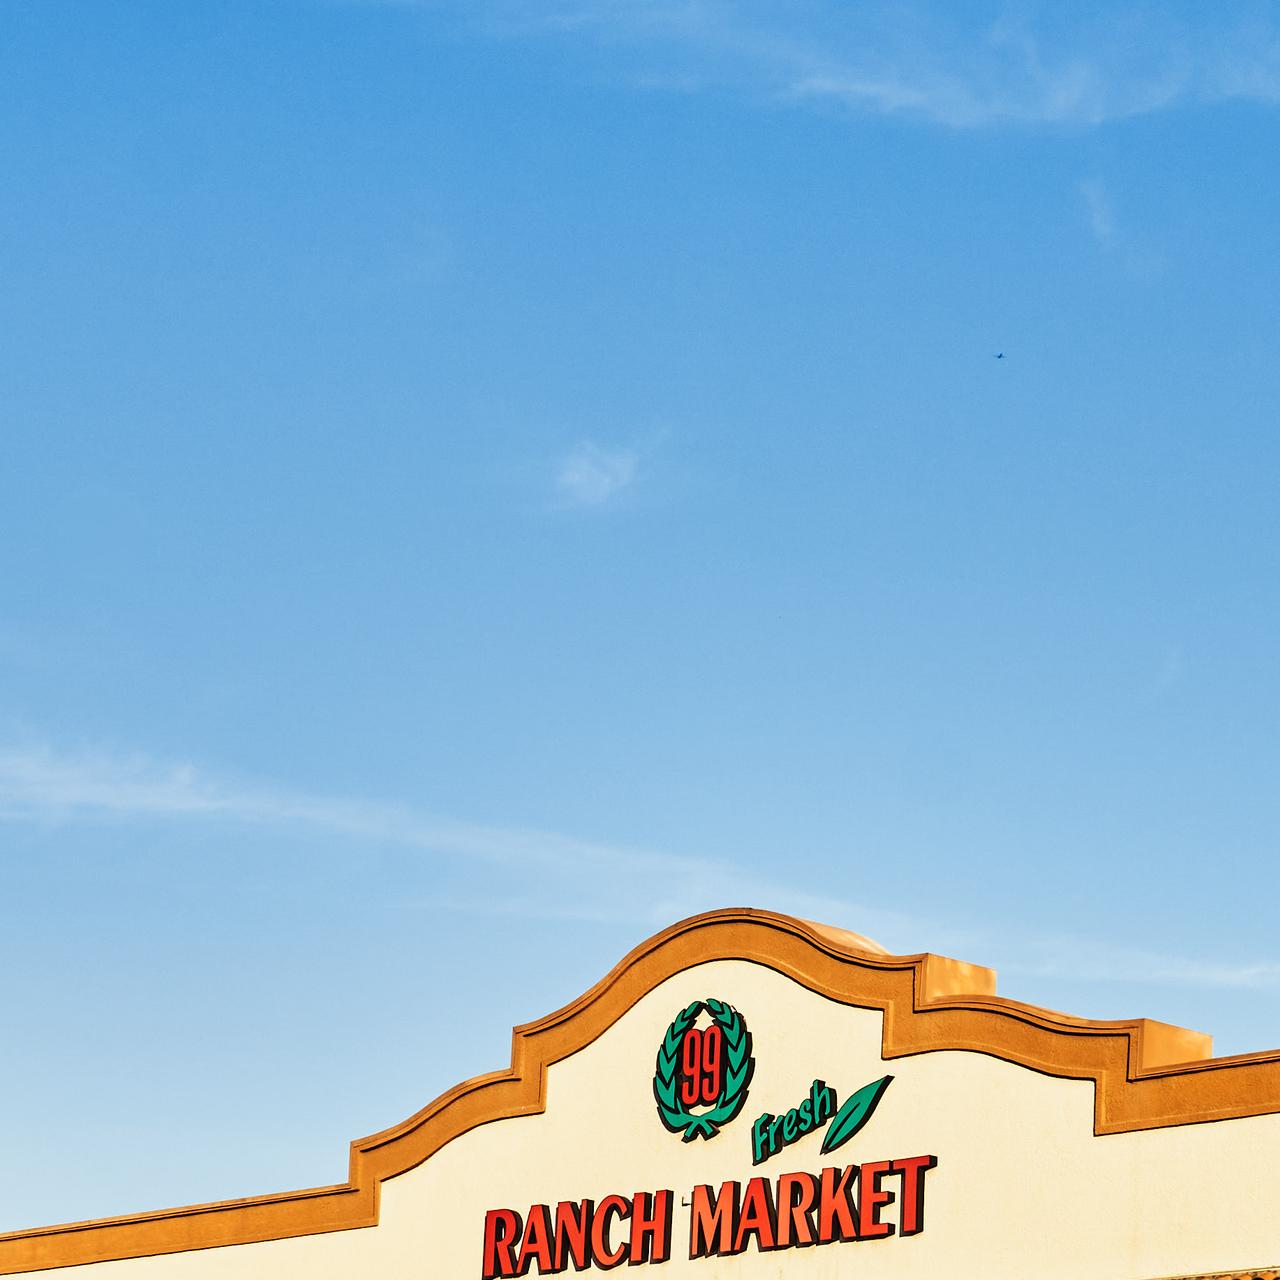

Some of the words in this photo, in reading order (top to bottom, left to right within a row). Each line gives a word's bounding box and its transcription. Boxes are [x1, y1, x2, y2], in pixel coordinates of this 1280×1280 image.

[681, 1025, 722, 1105] 99
[482, 1189, 674, 1280] RANCH
[688, 1155, 937, 1260] MARKET
